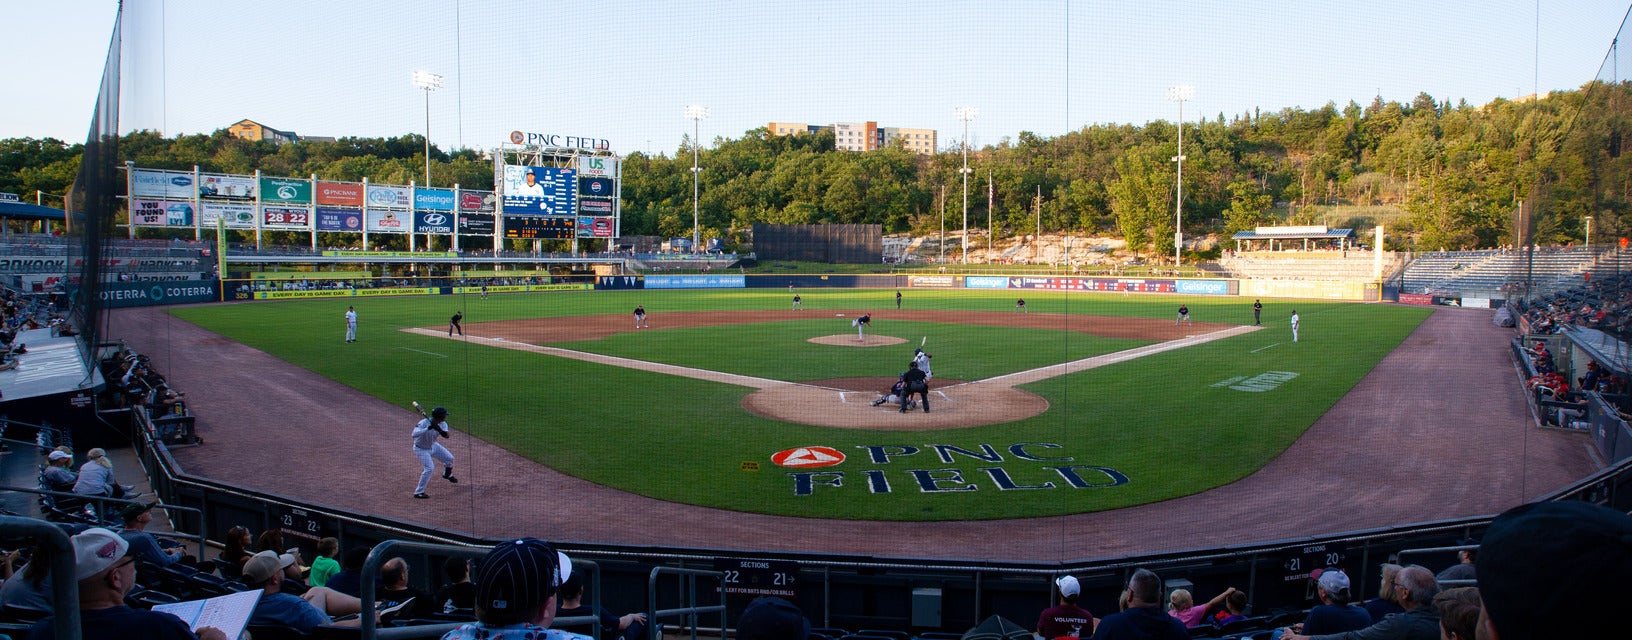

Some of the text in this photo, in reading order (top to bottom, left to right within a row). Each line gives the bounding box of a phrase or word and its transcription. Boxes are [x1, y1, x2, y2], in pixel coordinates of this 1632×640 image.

[528, 132, 610, 150] PNC FIELD
[416, 194, 453, 204] Geisinger
[268, 213, 306, 223] 28 22
[971, 277, 1003, 287] Geisinger
[1182, 282, 1223, 292] Geisinger
[99, 289, 146, 301] OTERRA
[167, 286, 213, 297] COTERRA
[856, 442, 1073, 464] PNC
[786, 465, 1131, 496] FIELD
[284, 514, 317, 532] 23 22
[1303, 545, 1326, 553] SECTIONS
[740, 561, 770, 569] SECTIONS
[1290, 552, 1339, 571] 21 20
[724, 570, 786, 586] 22 21
